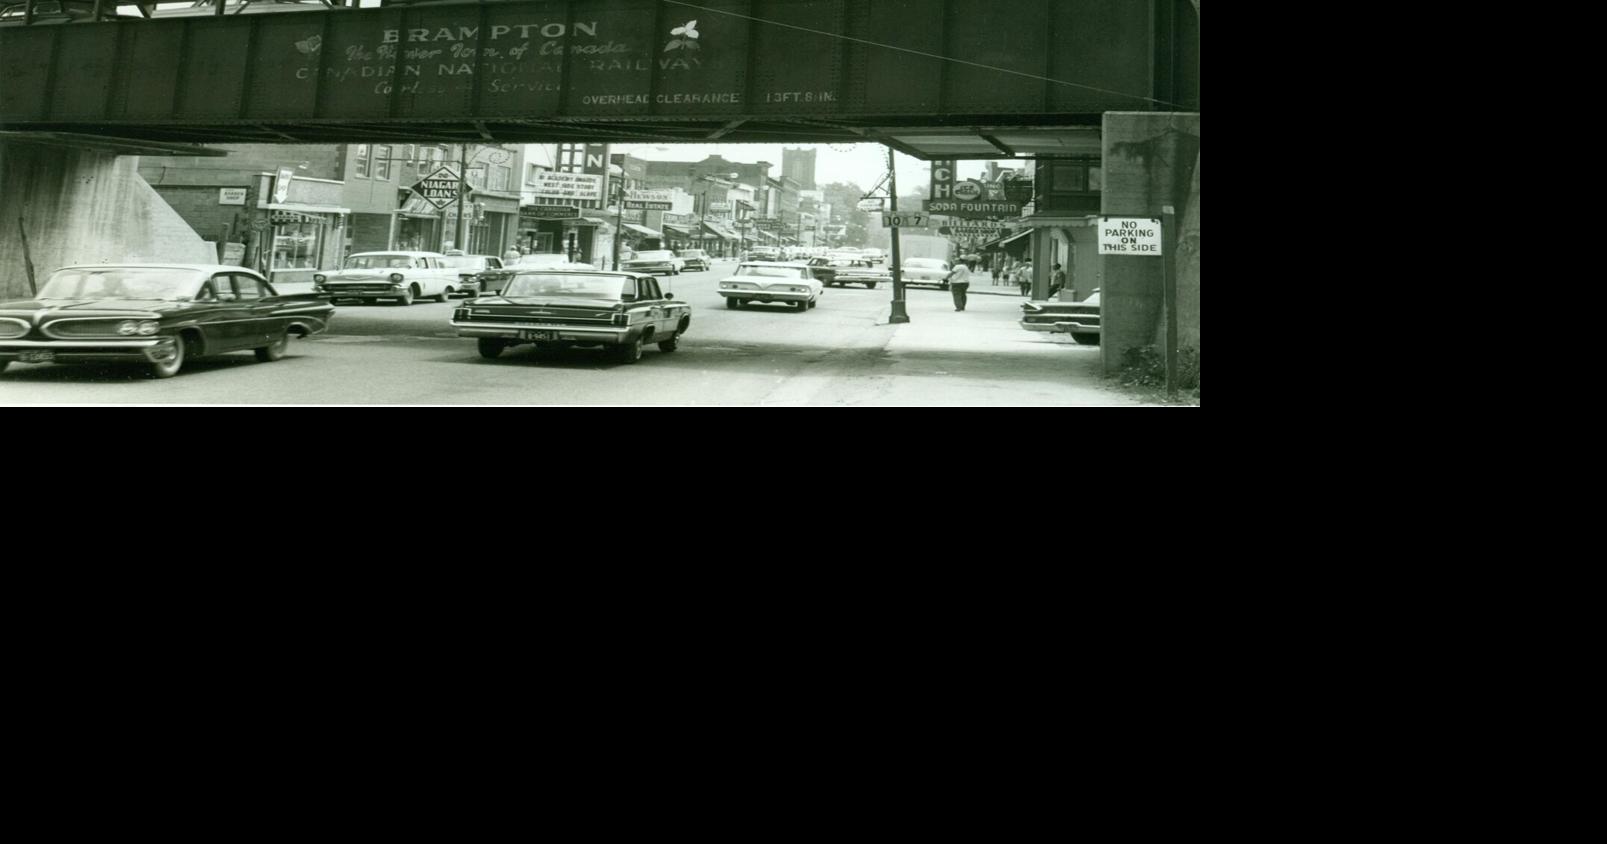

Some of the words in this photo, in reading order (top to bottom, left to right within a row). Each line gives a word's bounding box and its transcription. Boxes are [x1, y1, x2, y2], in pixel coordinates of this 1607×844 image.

[381, 21, 598, 45] BRAMPTON
[296, 65, 420, 79] CNADIAN
[582, 95, 649, 106] OVERHEAD
[656, 93, 740, 105] CLEARANCE
[420, 181, 461, 190] NIAGAR
[423, 189, 459, 199] LOANS
[929, 203, 957, 212] SODA
[961, 203, 1017, 212] FOUNTAIN
[887, 216, 901, 226] 10
[914, 216, 922, 226] 7
[1121, 221, 1137, 229] NO
[1105, 229, 1154, 238] PARKING
